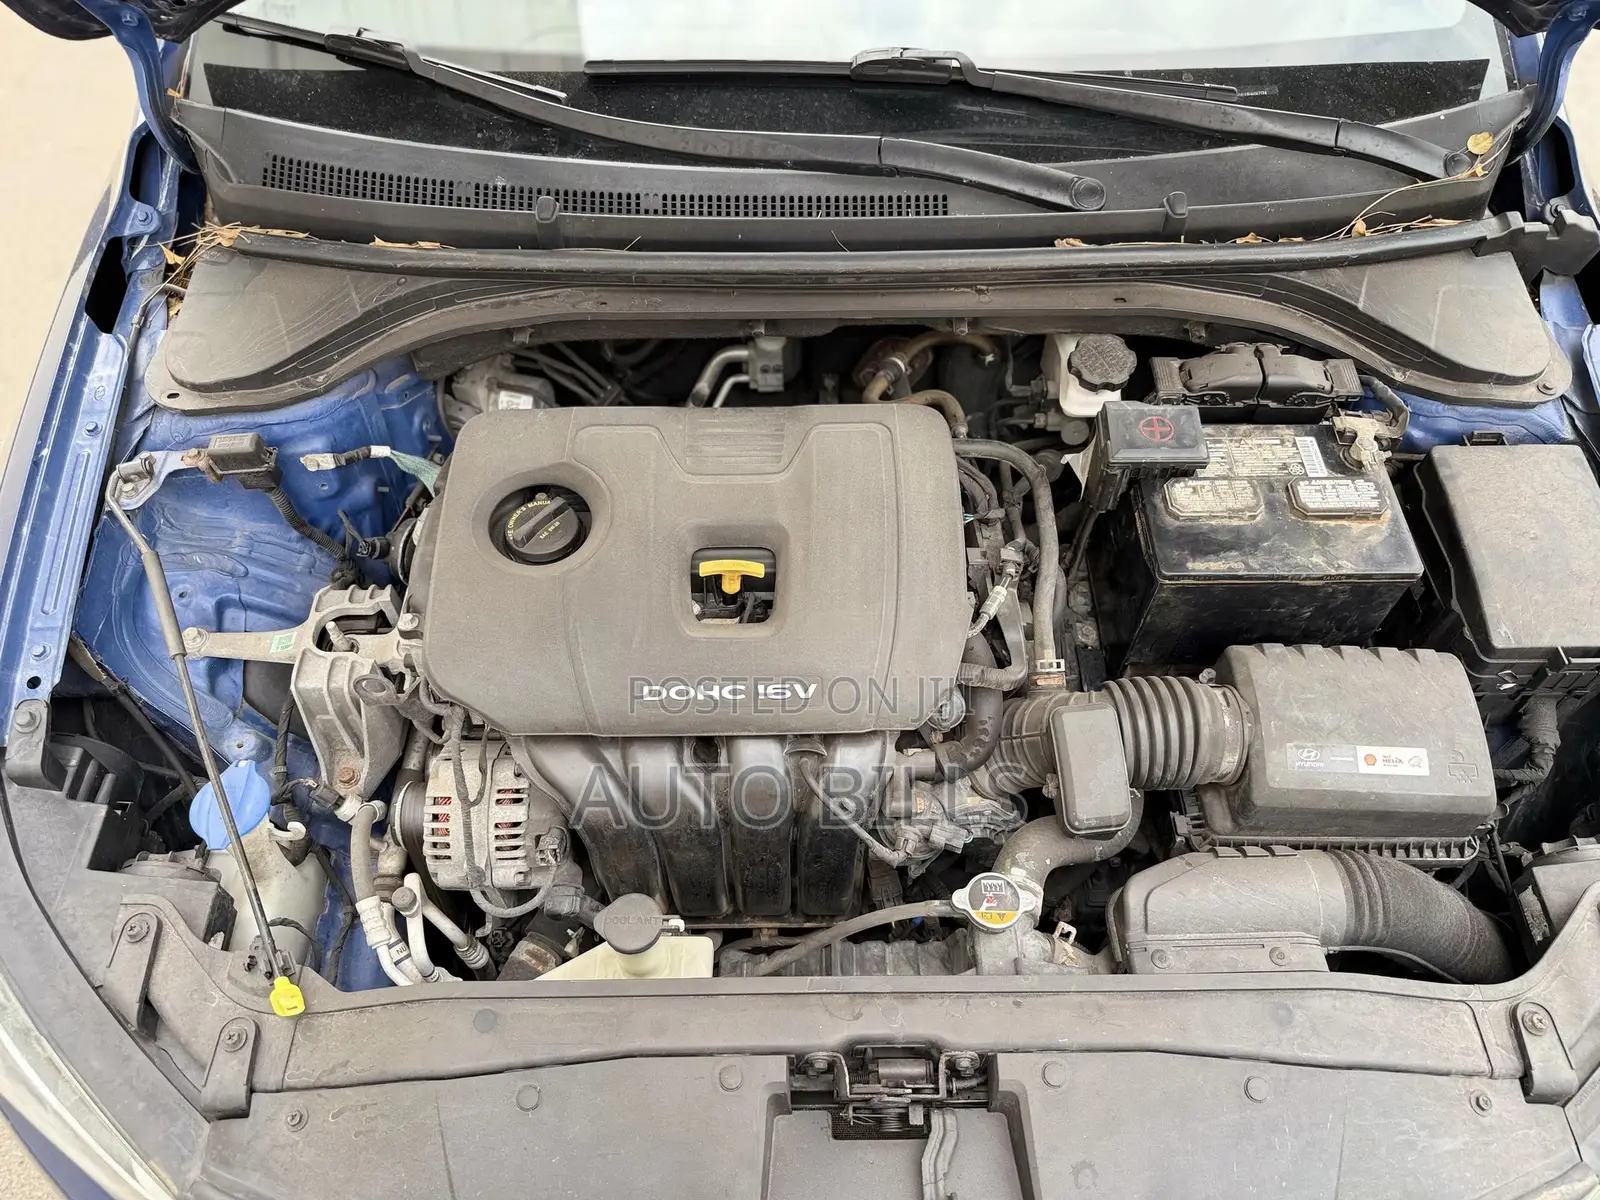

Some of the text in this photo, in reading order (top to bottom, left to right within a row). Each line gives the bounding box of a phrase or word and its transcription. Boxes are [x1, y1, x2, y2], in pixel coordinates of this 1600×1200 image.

[642, 683, 818, 701] DOHC 16V
[1295, 760, 1324, 768] HYUNDAI
[605, 915, 660, 926] COOLANT
